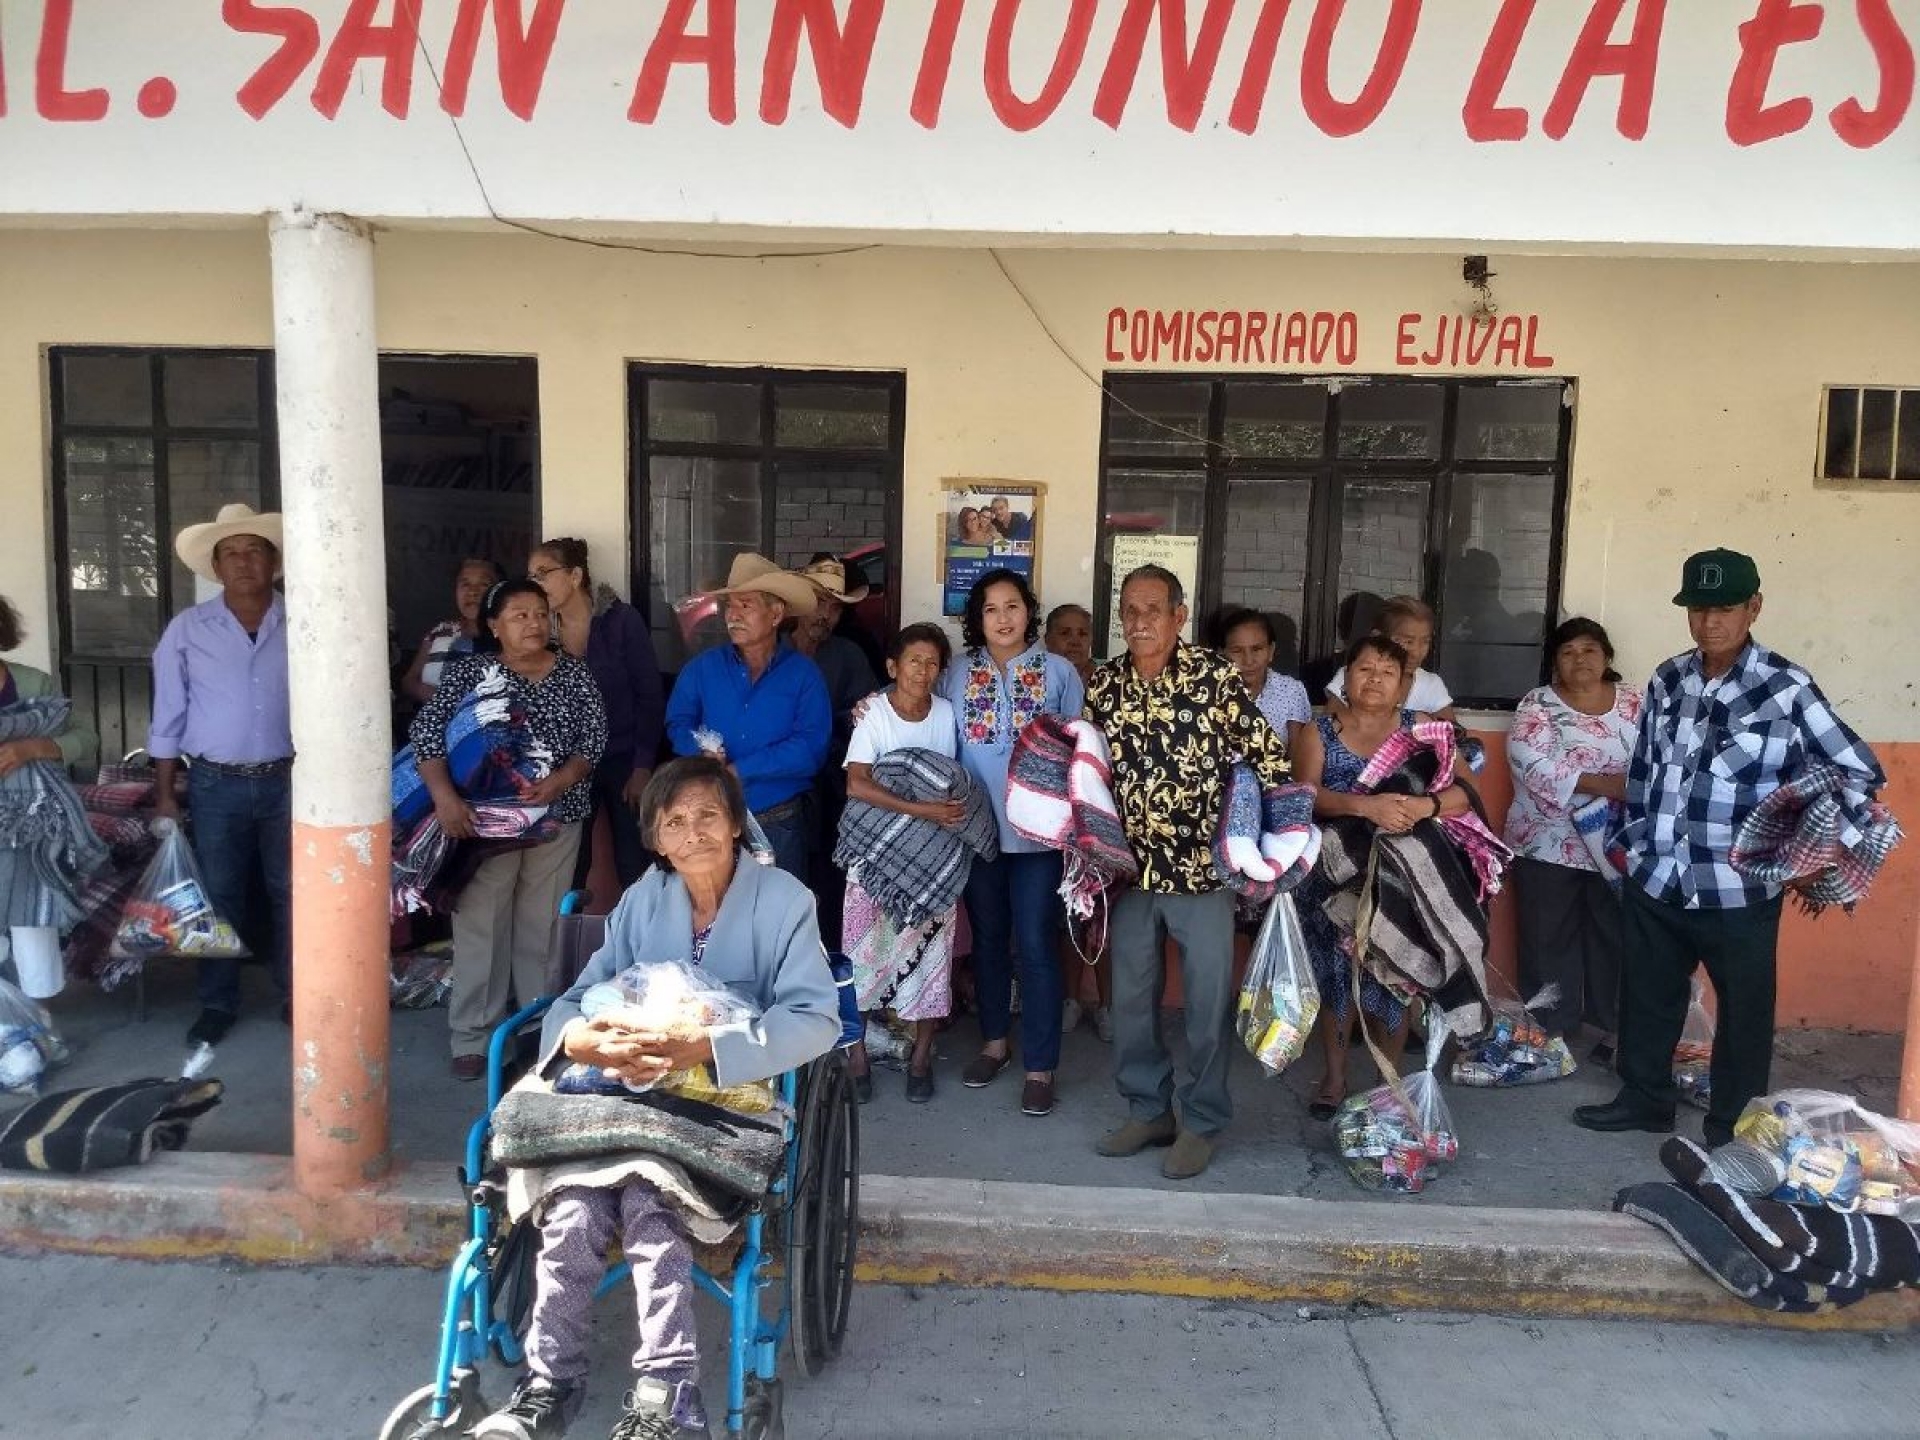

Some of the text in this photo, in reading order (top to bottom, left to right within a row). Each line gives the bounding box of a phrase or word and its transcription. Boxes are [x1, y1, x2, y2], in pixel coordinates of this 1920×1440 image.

[0, 0, 176, 122] L.
[221, 0, 565, 121] SAN
[628, 0, 1424, 137] ANTONIO
[1463, 0, 1666, 142] LA
[1105, 306, 1555, 369] COMISARIADO EJIDAL
[1697, 563, 1723, 590] D
